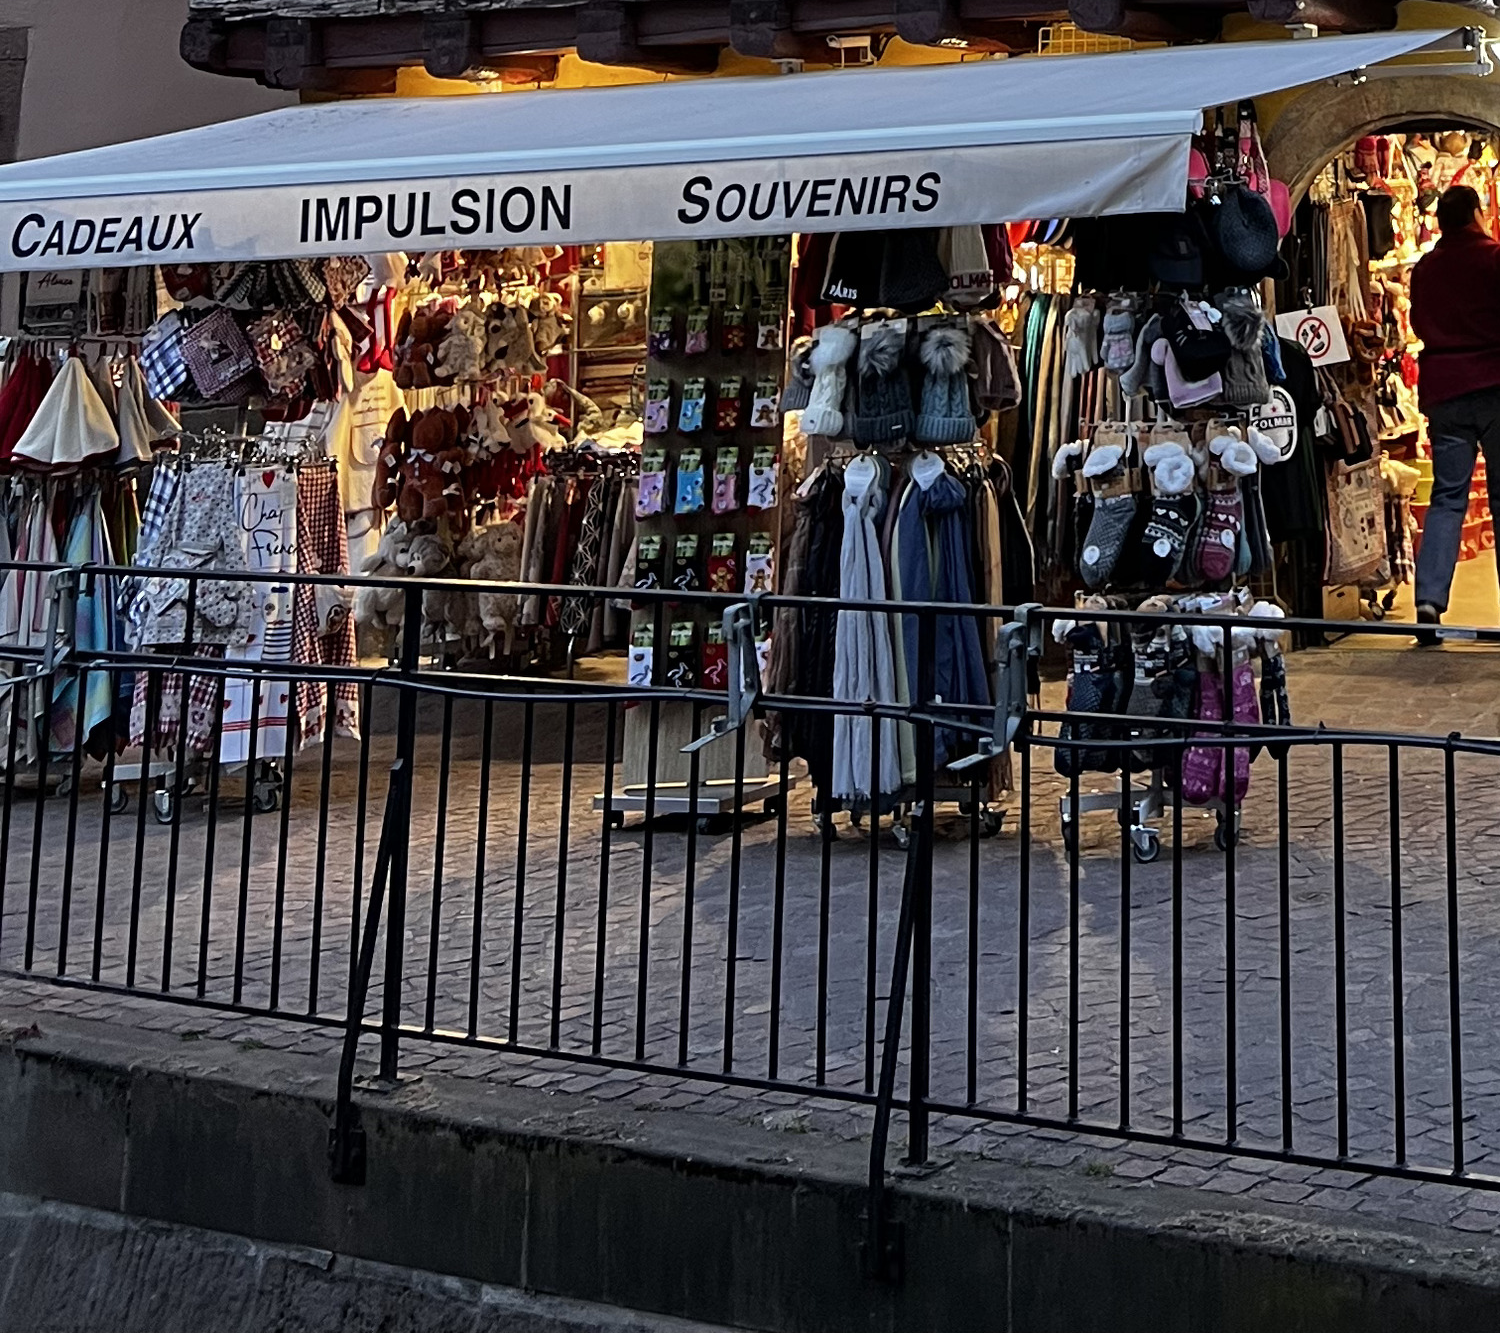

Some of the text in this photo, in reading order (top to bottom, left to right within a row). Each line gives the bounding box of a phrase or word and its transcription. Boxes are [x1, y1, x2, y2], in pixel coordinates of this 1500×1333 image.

[12, 172, 941, 258] CADEAUX IMPULSION SOUVENIRS
[951, 274, 991, 289] OLMA
[1252, 417, 1292, 429] COLMAR
[251, 529, 299, 567] Frenc
